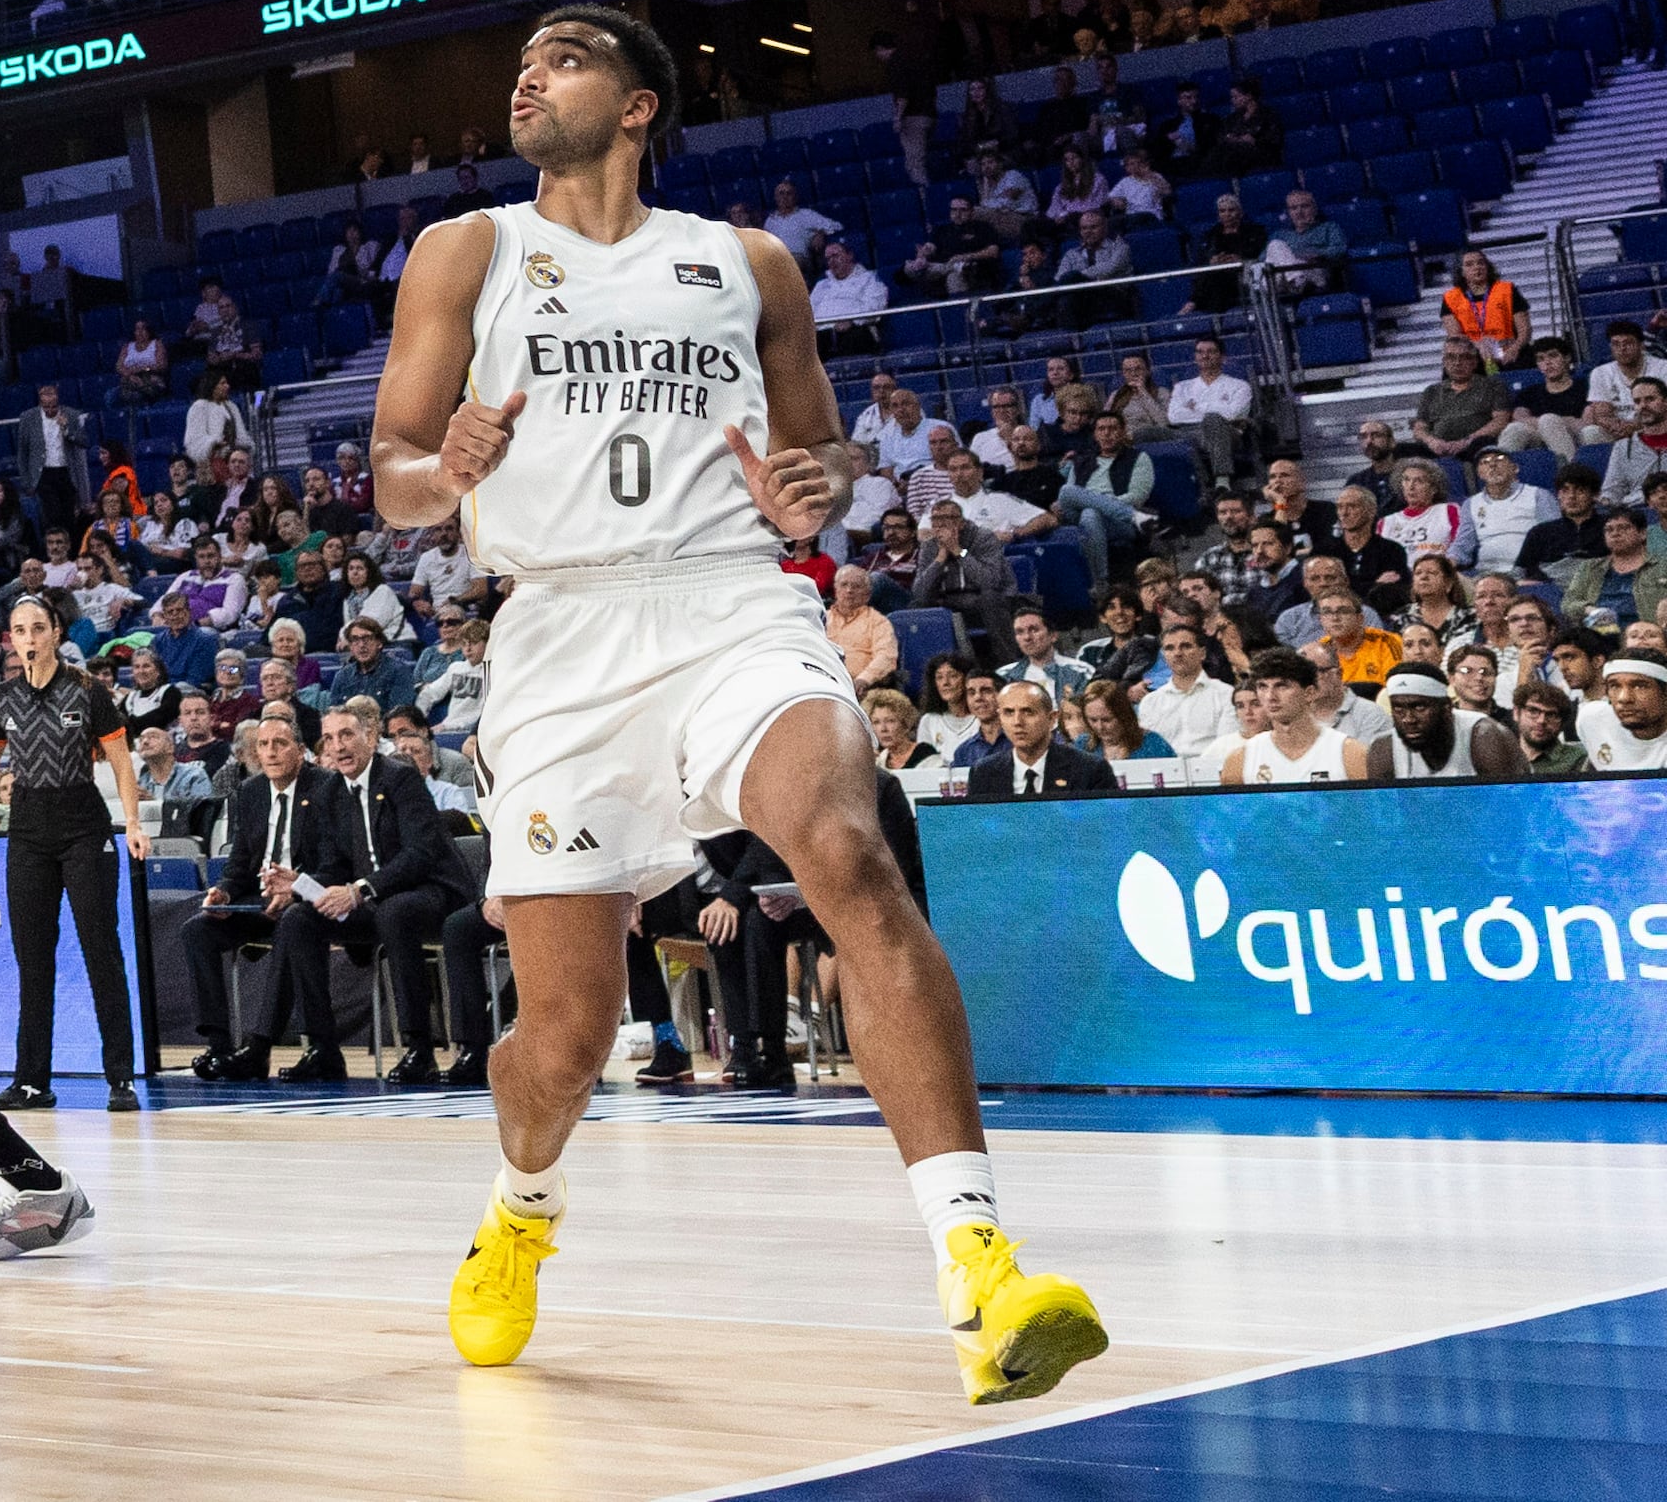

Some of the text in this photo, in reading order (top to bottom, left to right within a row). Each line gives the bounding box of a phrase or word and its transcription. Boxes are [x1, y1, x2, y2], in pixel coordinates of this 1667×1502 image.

[525, 330, 741, 383] Emirates
[565, 378, 708, 419] FLY BETTER
[609, 433, 651, 507] 0
